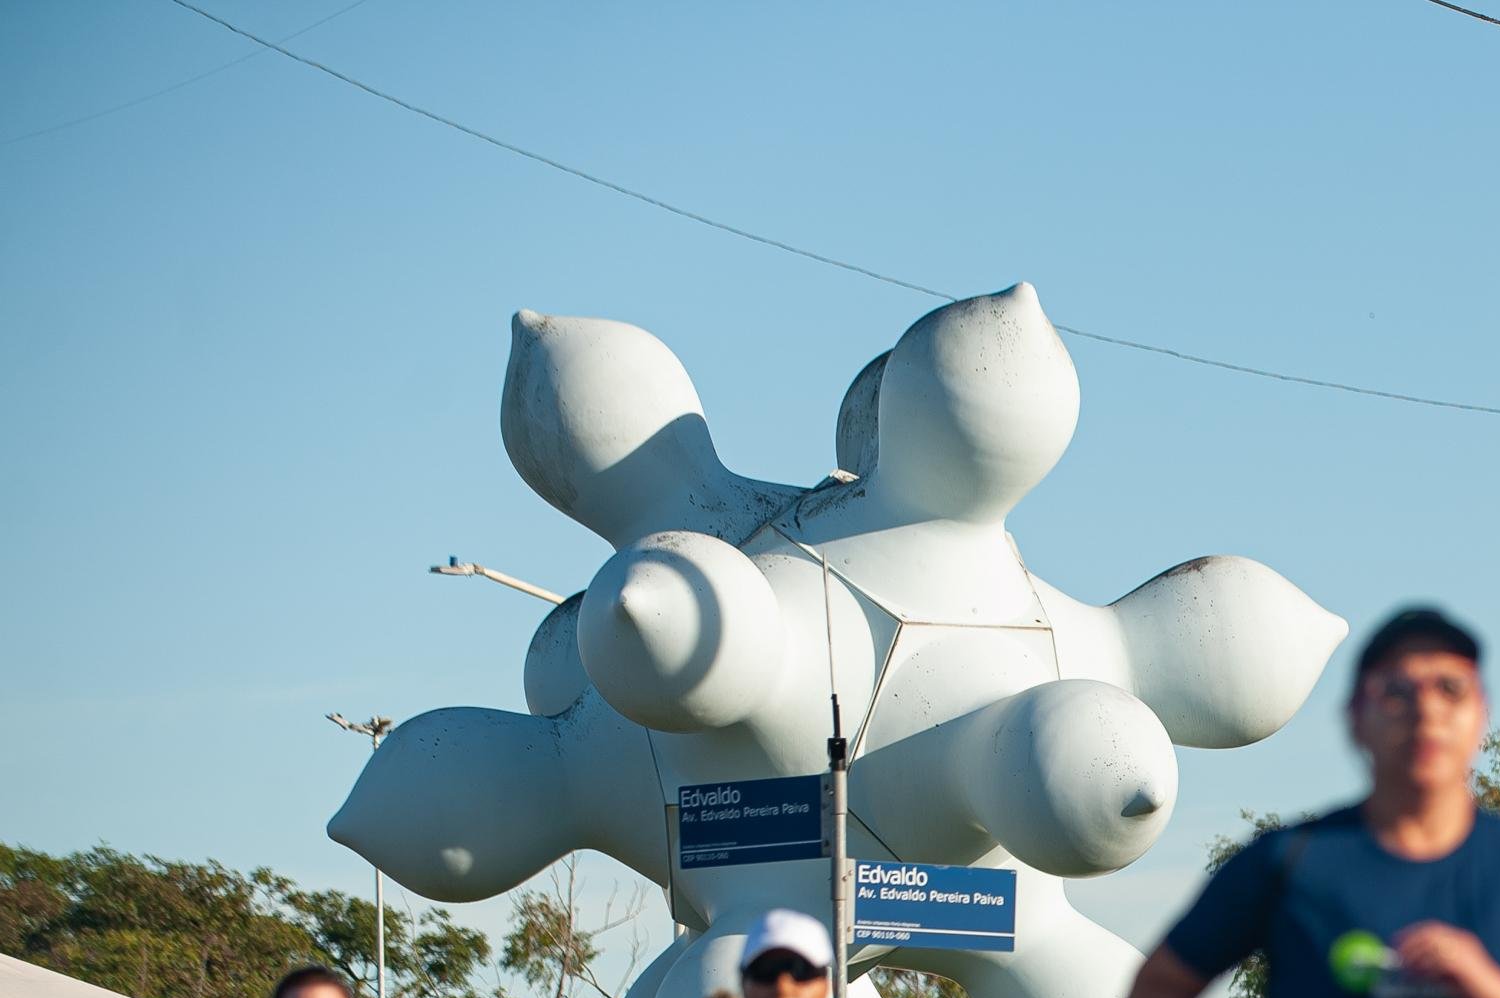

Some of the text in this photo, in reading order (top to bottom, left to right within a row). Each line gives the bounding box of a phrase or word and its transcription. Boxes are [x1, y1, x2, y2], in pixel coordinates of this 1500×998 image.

[681, 786, 741, 808] Edvaldo
[682, 802, 810, 823] Av. Edvaldo Pereira Paiva
[858, 865, 928, 887] Edvaldo
[858, 887, 1005, 906] Av. Edvaldo Pereira Paiva
